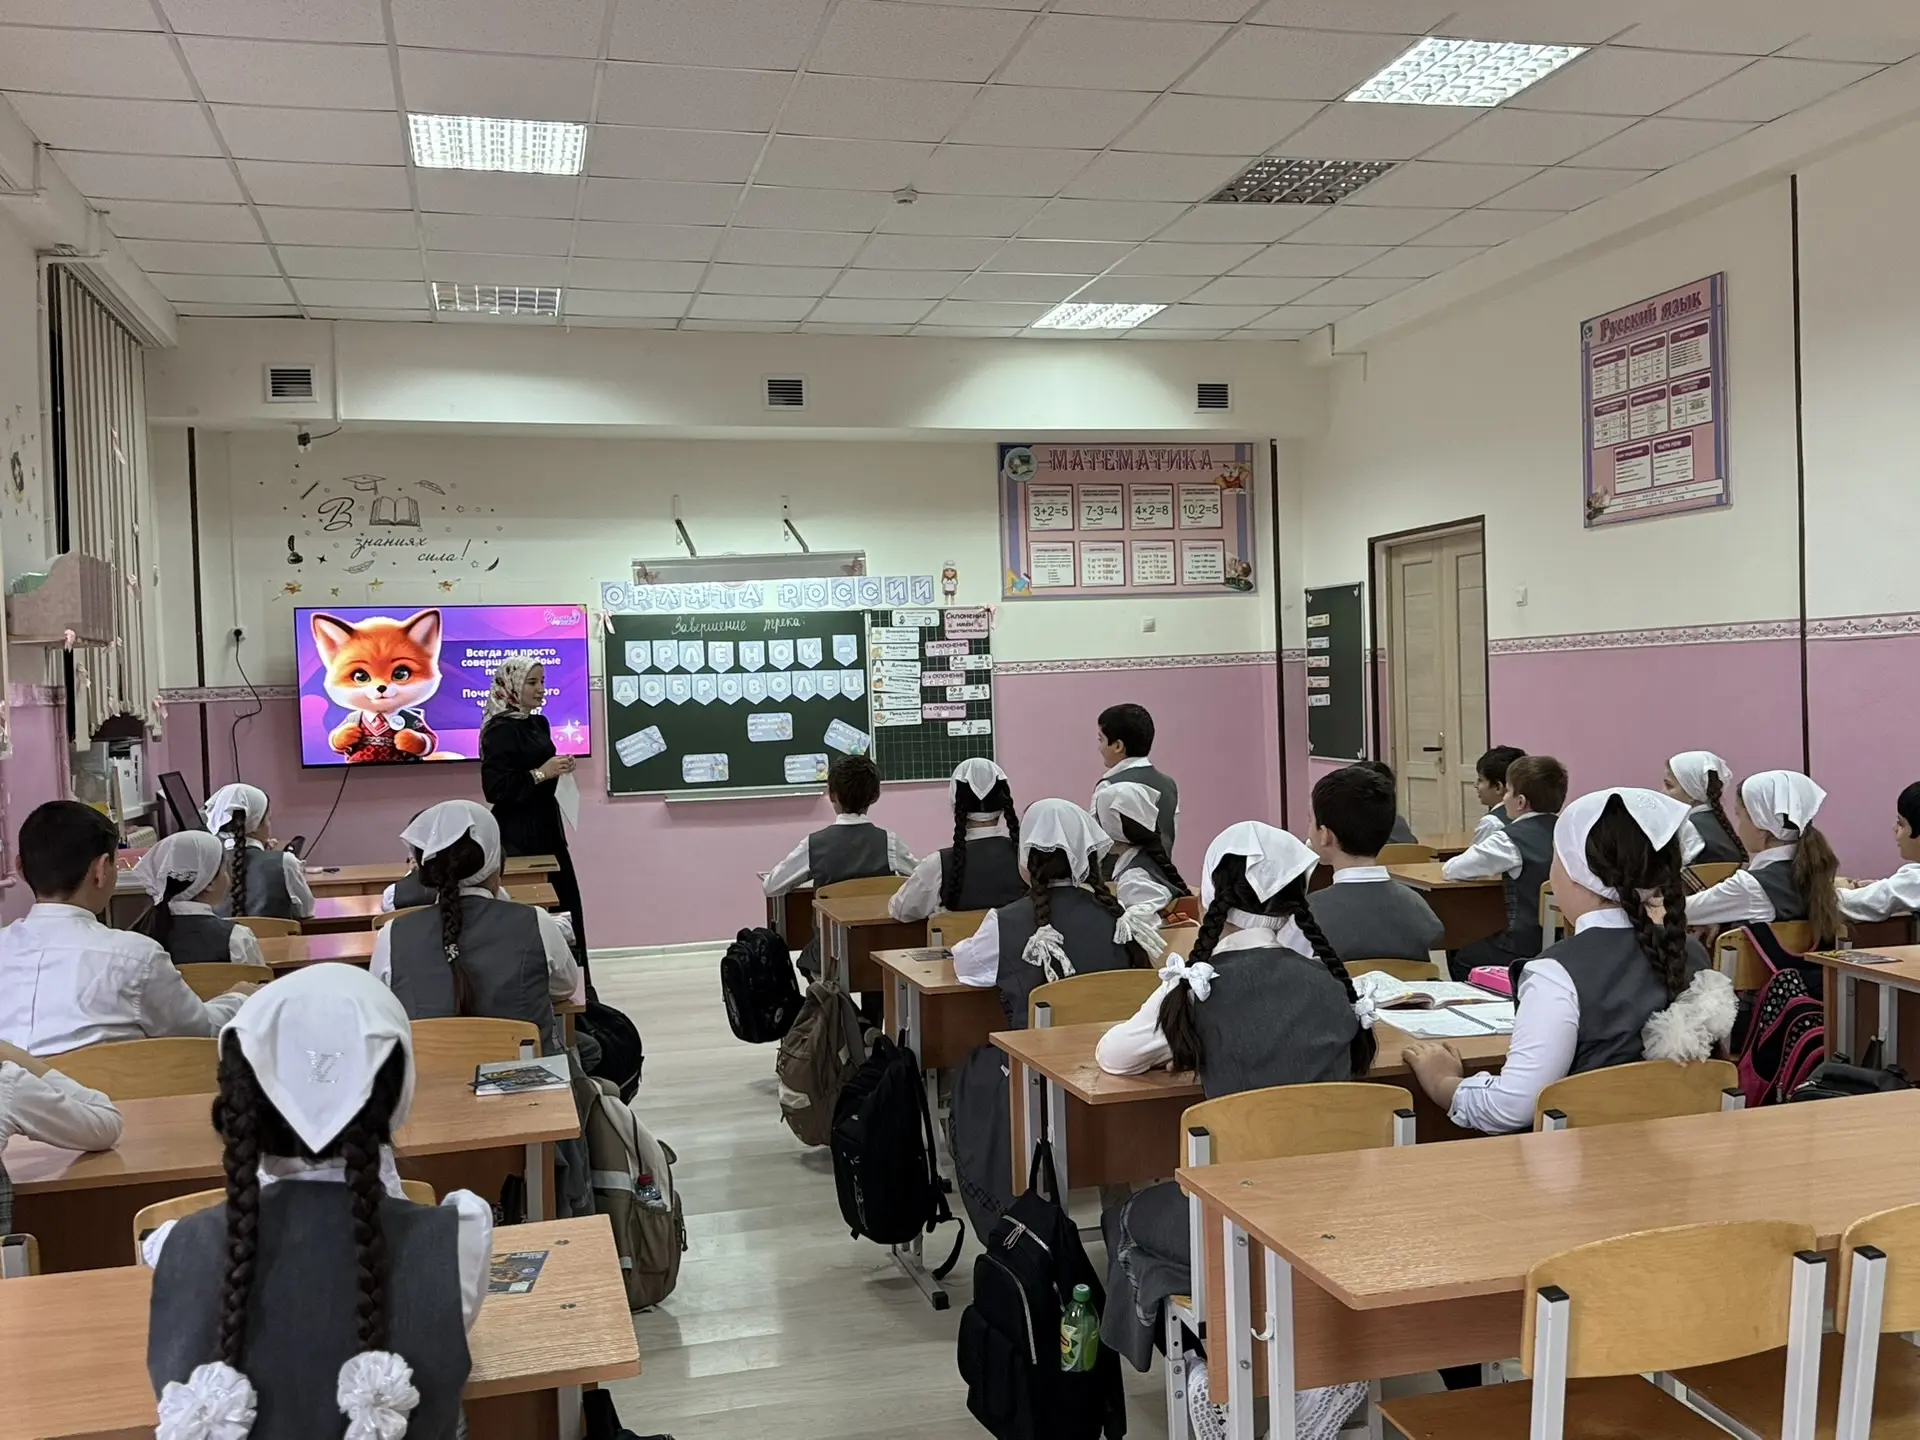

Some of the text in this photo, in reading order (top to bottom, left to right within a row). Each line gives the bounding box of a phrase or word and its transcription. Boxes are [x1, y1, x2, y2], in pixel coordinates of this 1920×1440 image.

[1600, 291, 1702, 342] Русский язык
[1049, 448, 1213, 472] МАТЕМАТИКА
[317, 496, 355, 532] В
[1033, 505, 1069, 517] 3+2=5
[1085, 505, 1118, 516] 7-3=4
[1183, 504, 1219, 515] 10:2=5
[350, 537, 428, 559] знаниях
[604, 578, 932, 606] ОРЛЯТА РОССИИ
[671, 614, 748, 638] Завершение
[461, 658, 503, 668] соверш
[466, 648, 557, 658] Всегда ли просто
[629, 642, 817, 665] ОРЛЁНОК
[462, 688, 490, 698] Поче
[617, 674, 862, 700] ДОБРОВОЛЕЦ
